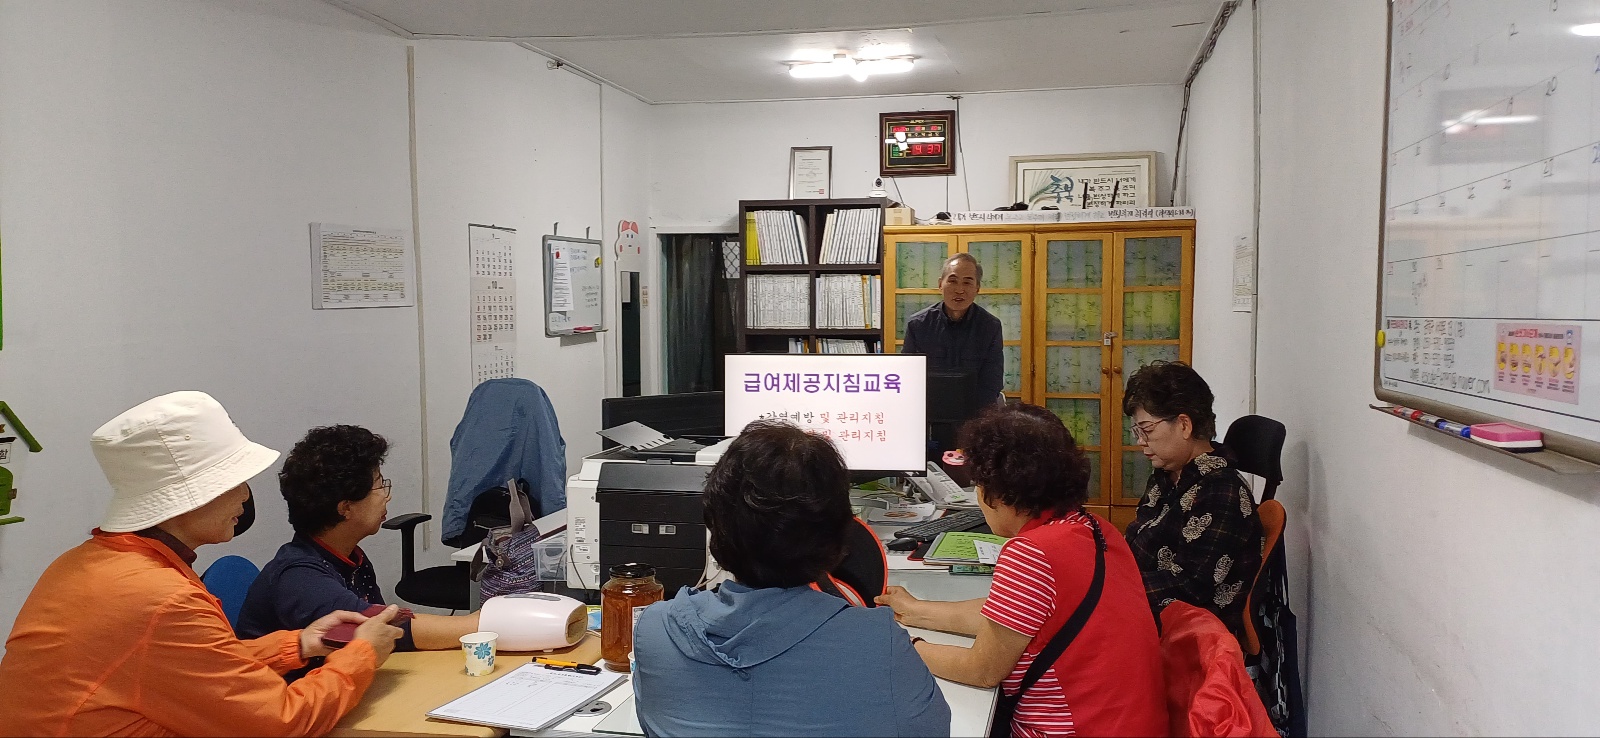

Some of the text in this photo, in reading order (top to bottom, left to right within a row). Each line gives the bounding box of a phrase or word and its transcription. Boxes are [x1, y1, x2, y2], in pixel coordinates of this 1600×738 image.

[744, 372, 901, 393] 급여제공지침교육
[819, 411, 830, 424] 및
[836, 411, 885, 425] 관리지침
[838, 429, 887, 442] 관리지침
